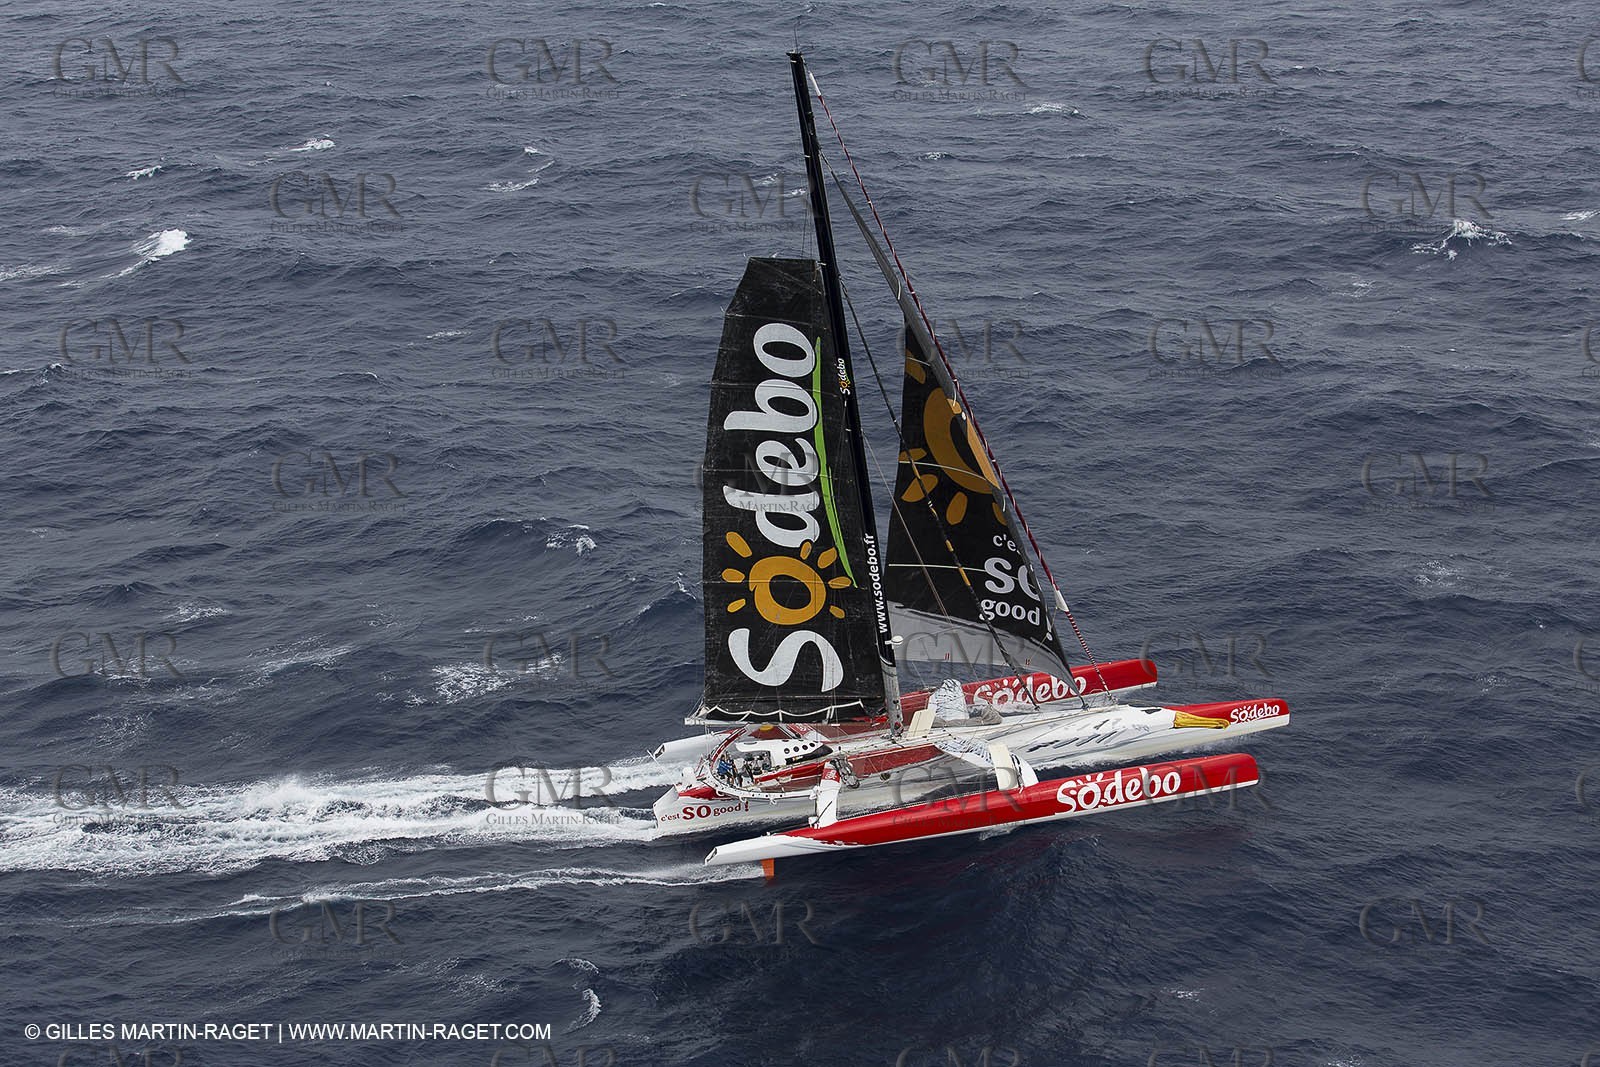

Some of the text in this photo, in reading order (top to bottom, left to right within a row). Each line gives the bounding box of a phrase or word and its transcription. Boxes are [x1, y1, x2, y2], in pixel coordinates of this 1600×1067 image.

[723, 322, 844, 692] Sodebo
[993, 534, 1021, 555] c'e
[863, 533, 888, 633] www.sodebo.fr
[979, 599, 1040, 626] good
[660, 813, 680, 822] c'est
[682, 805, 711, 820] SO
[713, 801, 741, 816] good
